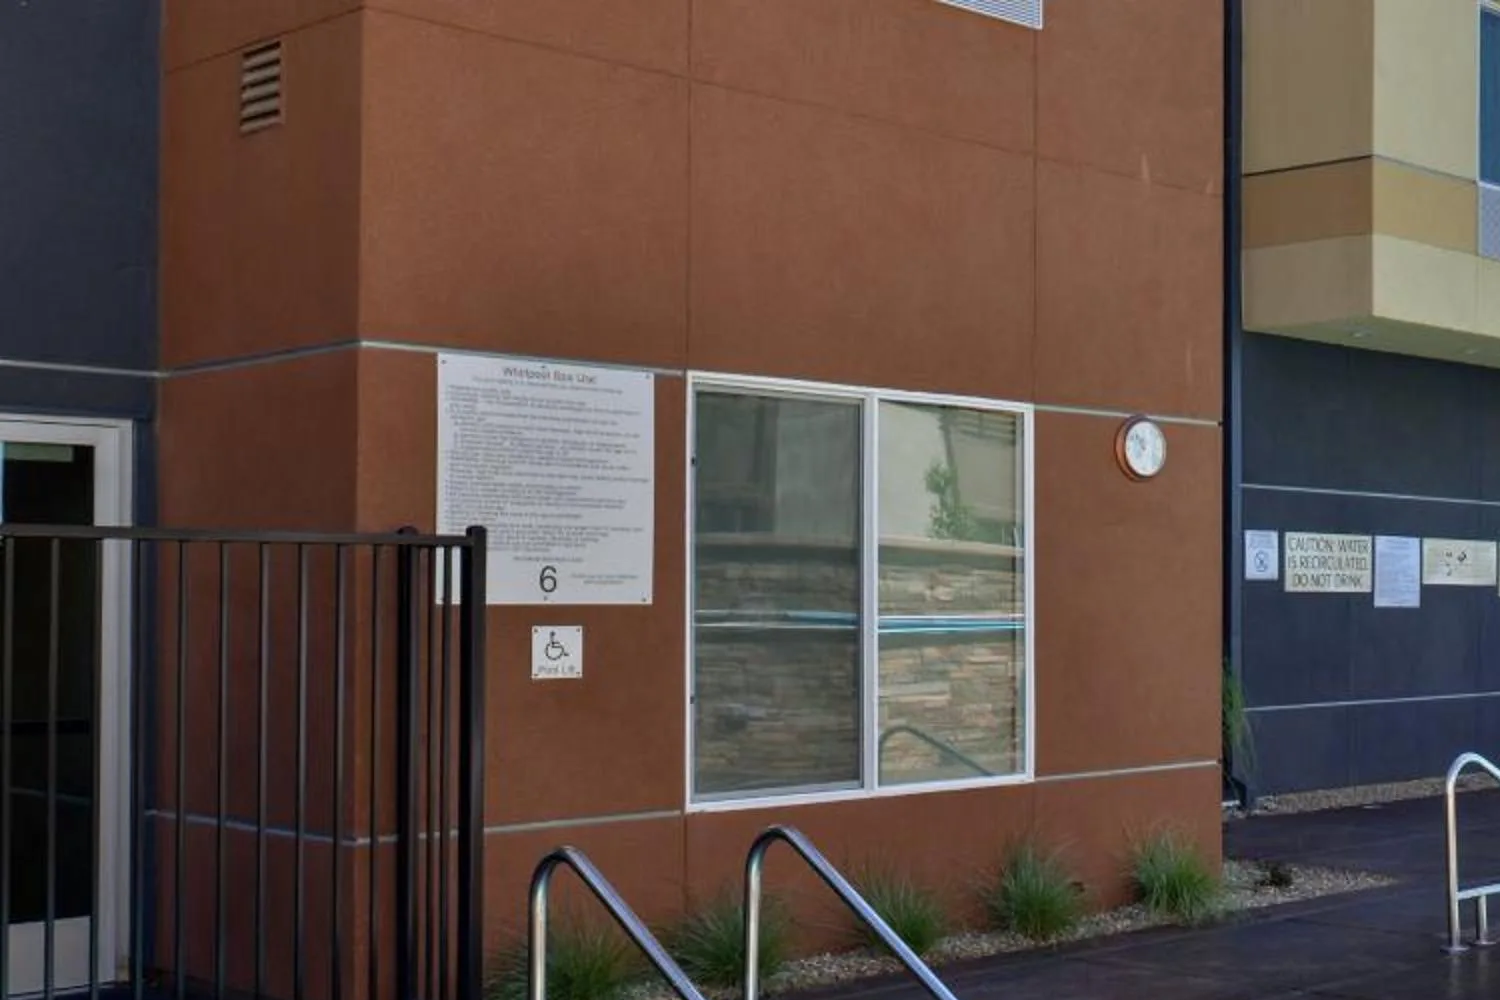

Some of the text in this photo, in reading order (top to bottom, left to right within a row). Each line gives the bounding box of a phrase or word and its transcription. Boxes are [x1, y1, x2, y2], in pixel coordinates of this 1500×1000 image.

[1338, 539, 1369, 554] WATER
[539, 565, 558, 593] 6
[1292, 573, 1362, 588] DO NOT DRINK
